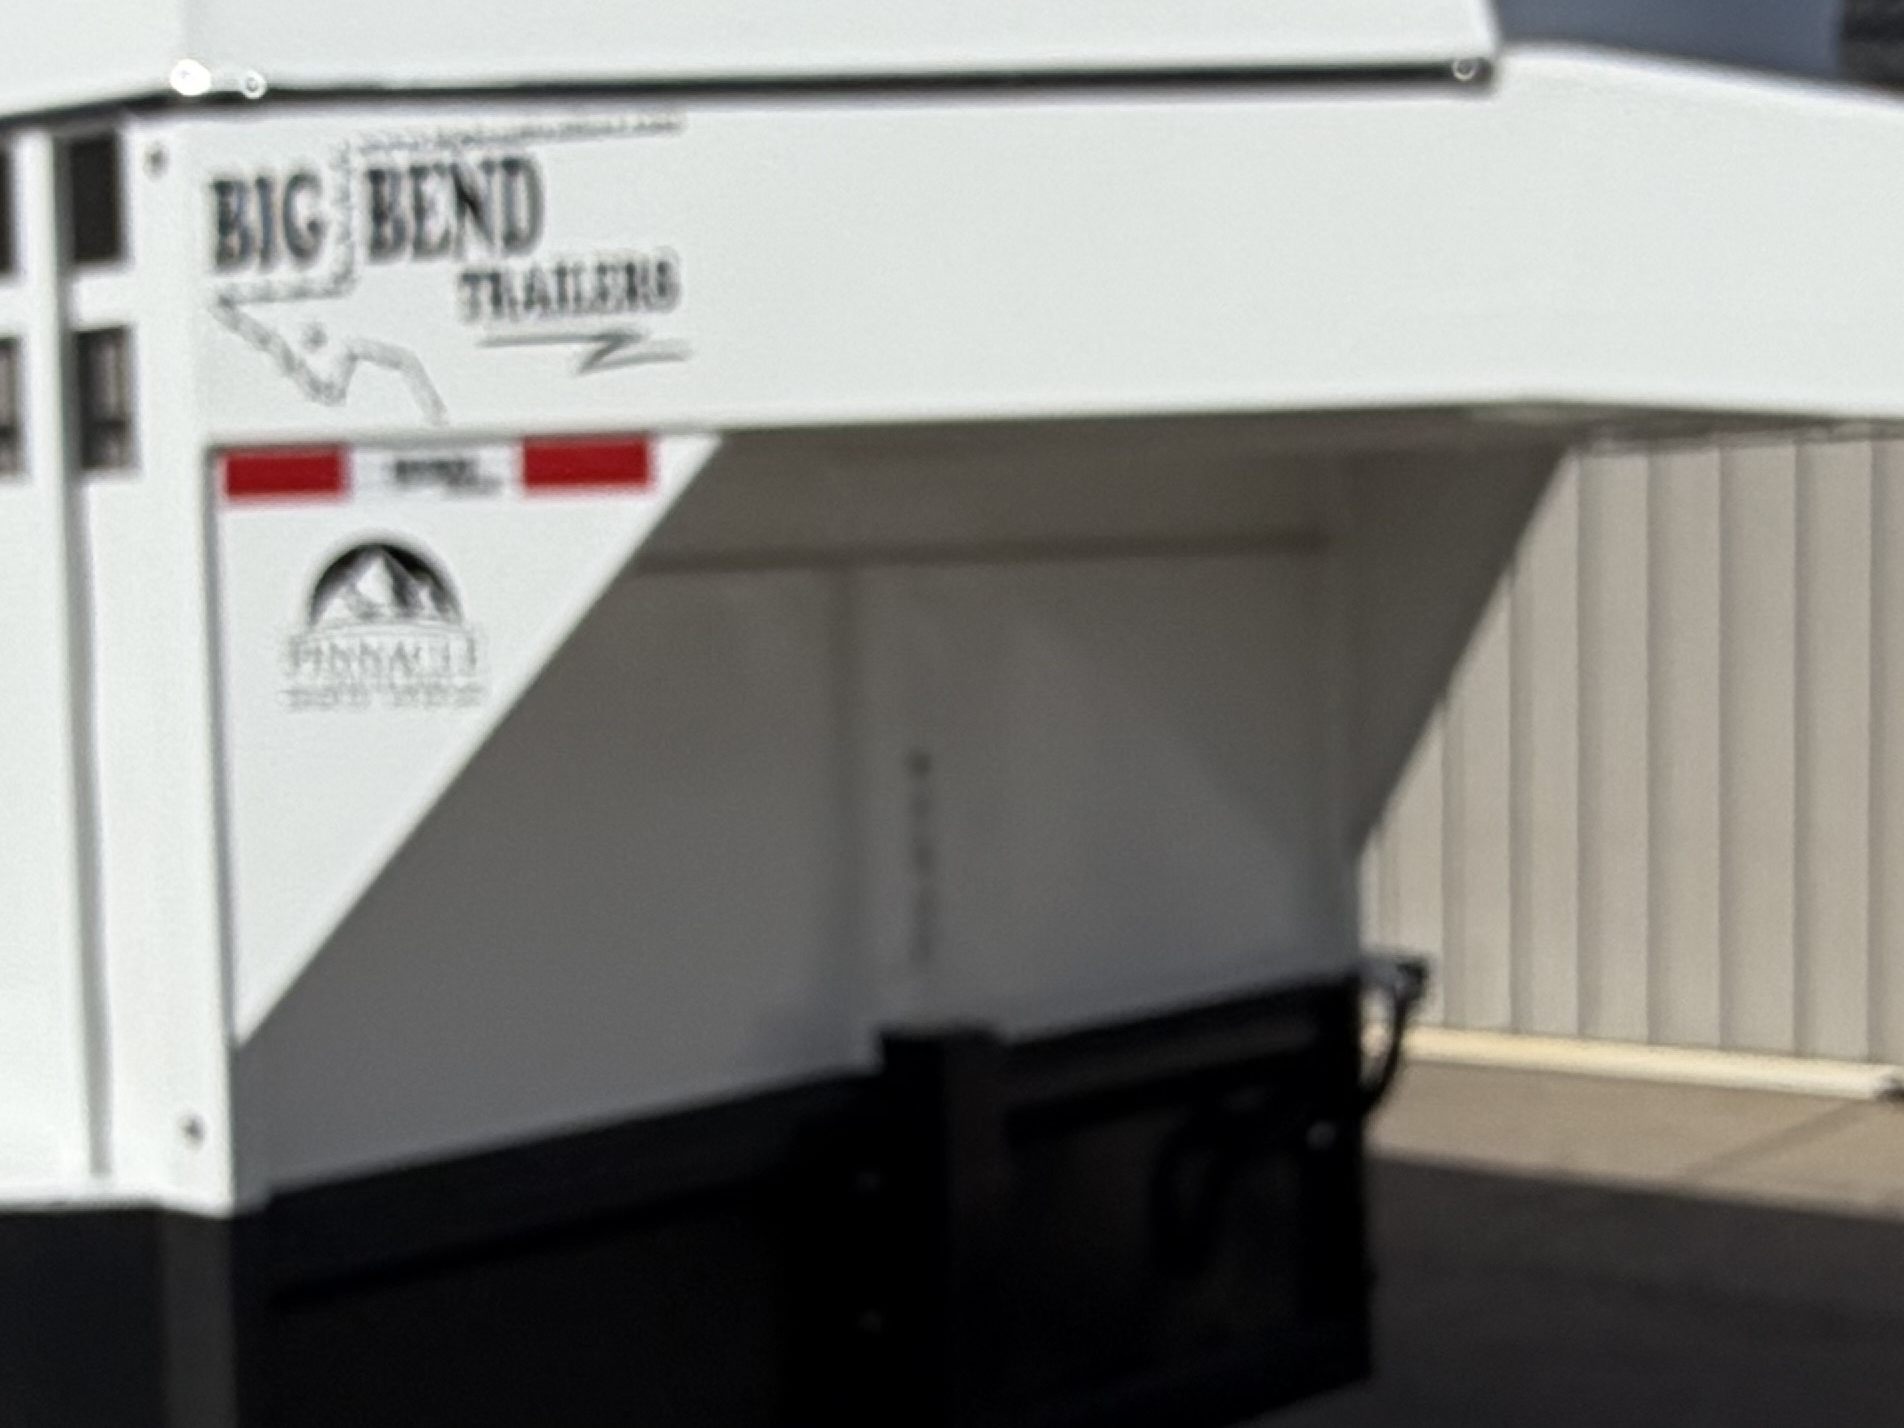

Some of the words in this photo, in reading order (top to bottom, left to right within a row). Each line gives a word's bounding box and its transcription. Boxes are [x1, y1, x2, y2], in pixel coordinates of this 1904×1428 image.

[210, 174, 327, 270] BIG
[364, 157, 546, 262] BEND
[459, 260, 679, 320] TRAILERS
